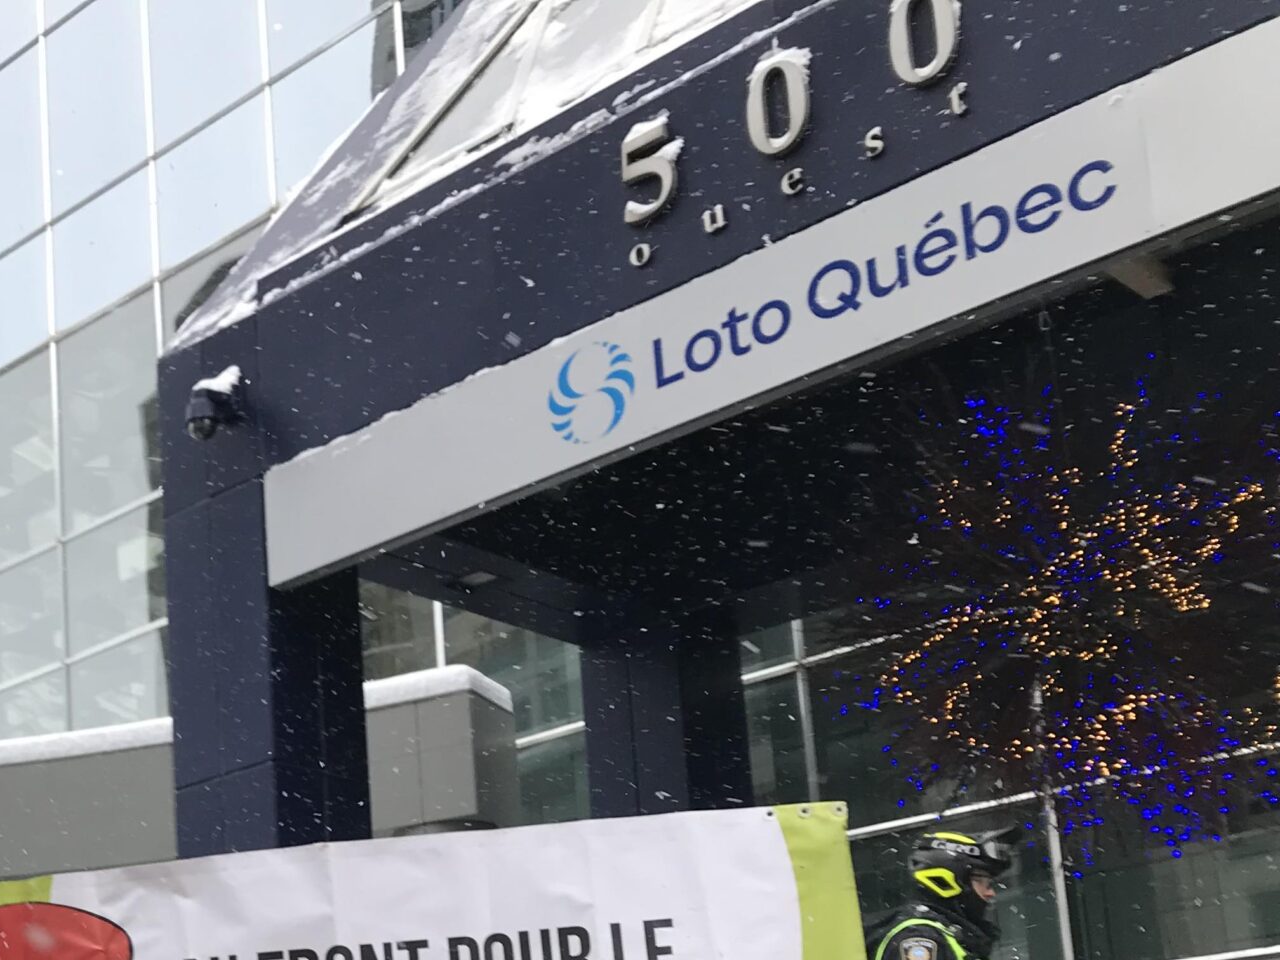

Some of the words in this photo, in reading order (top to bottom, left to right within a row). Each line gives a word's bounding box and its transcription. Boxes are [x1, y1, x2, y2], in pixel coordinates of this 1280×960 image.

[621, 0, 961, 225] 500
[652, 298, 792, 389] Loto
[807, 159, 1118, 322] Québec
